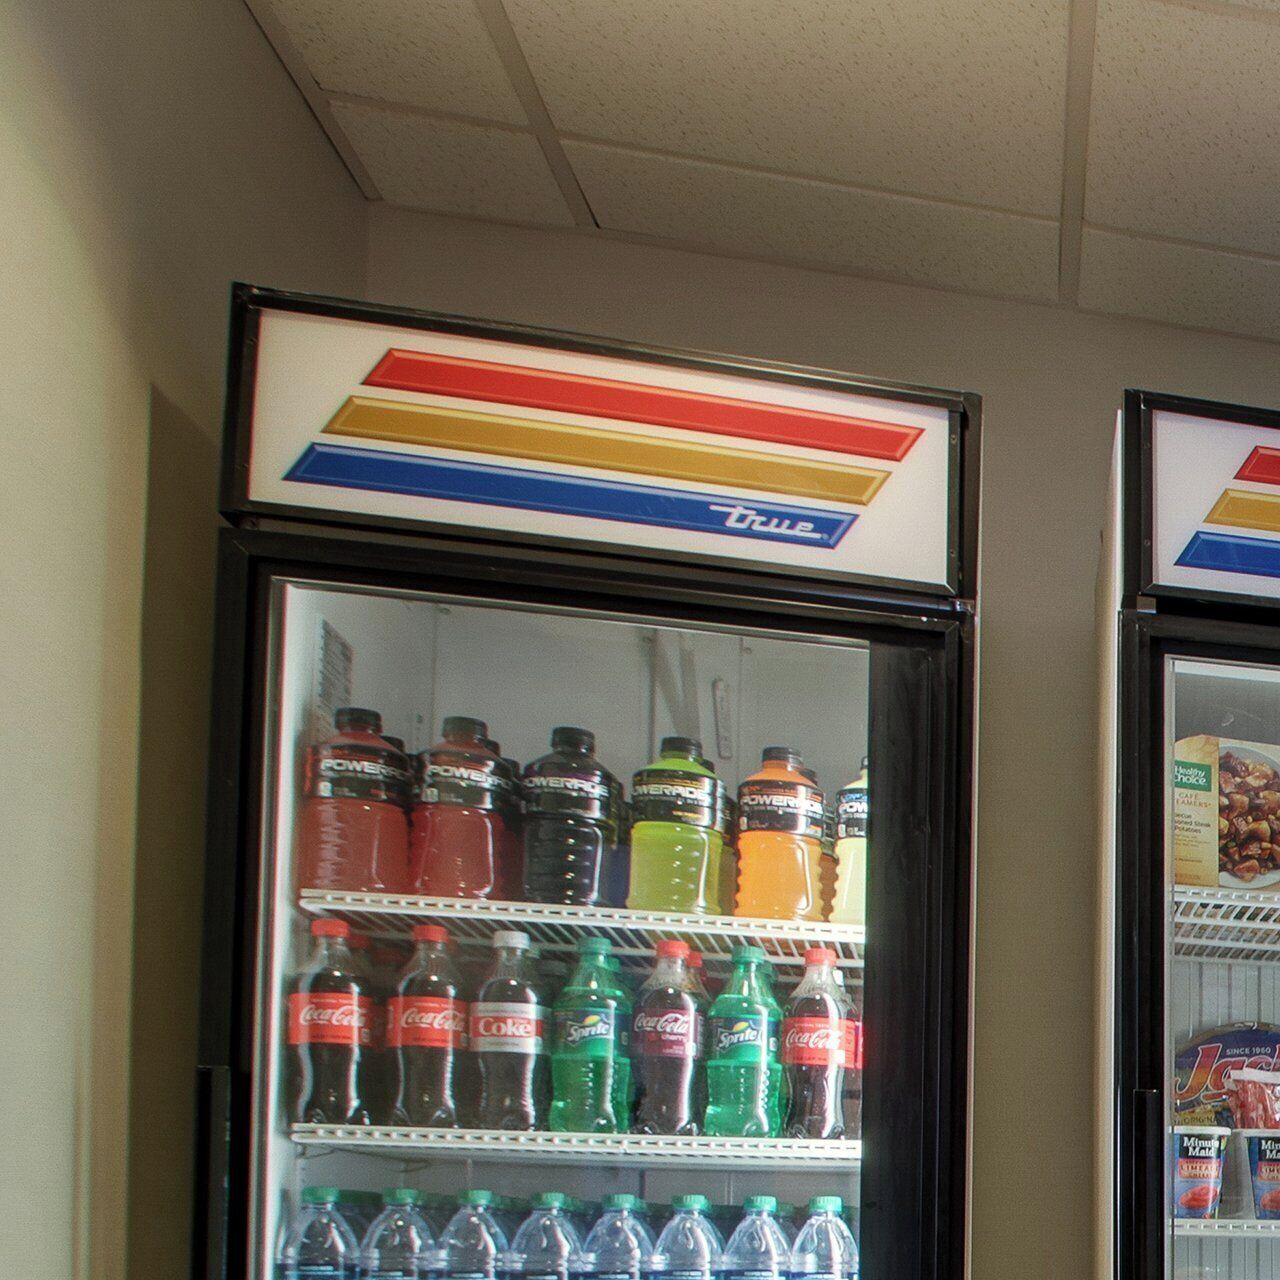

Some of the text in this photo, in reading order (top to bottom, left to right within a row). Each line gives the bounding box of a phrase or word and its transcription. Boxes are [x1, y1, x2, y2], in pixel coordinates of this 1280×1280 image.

[709, 503, 830, 539] true
[478, 1017, 534, 1037] Coke
[565, 1021, 610, 1042] Sprite
[717, 1028, 759, 1049] Sprite
[1226, 1047, 1271, 1055] SINCE 1960
[1183, 1136, 1219, 1148] Minute
[1188, 1146, 1214, 1156] Maid
